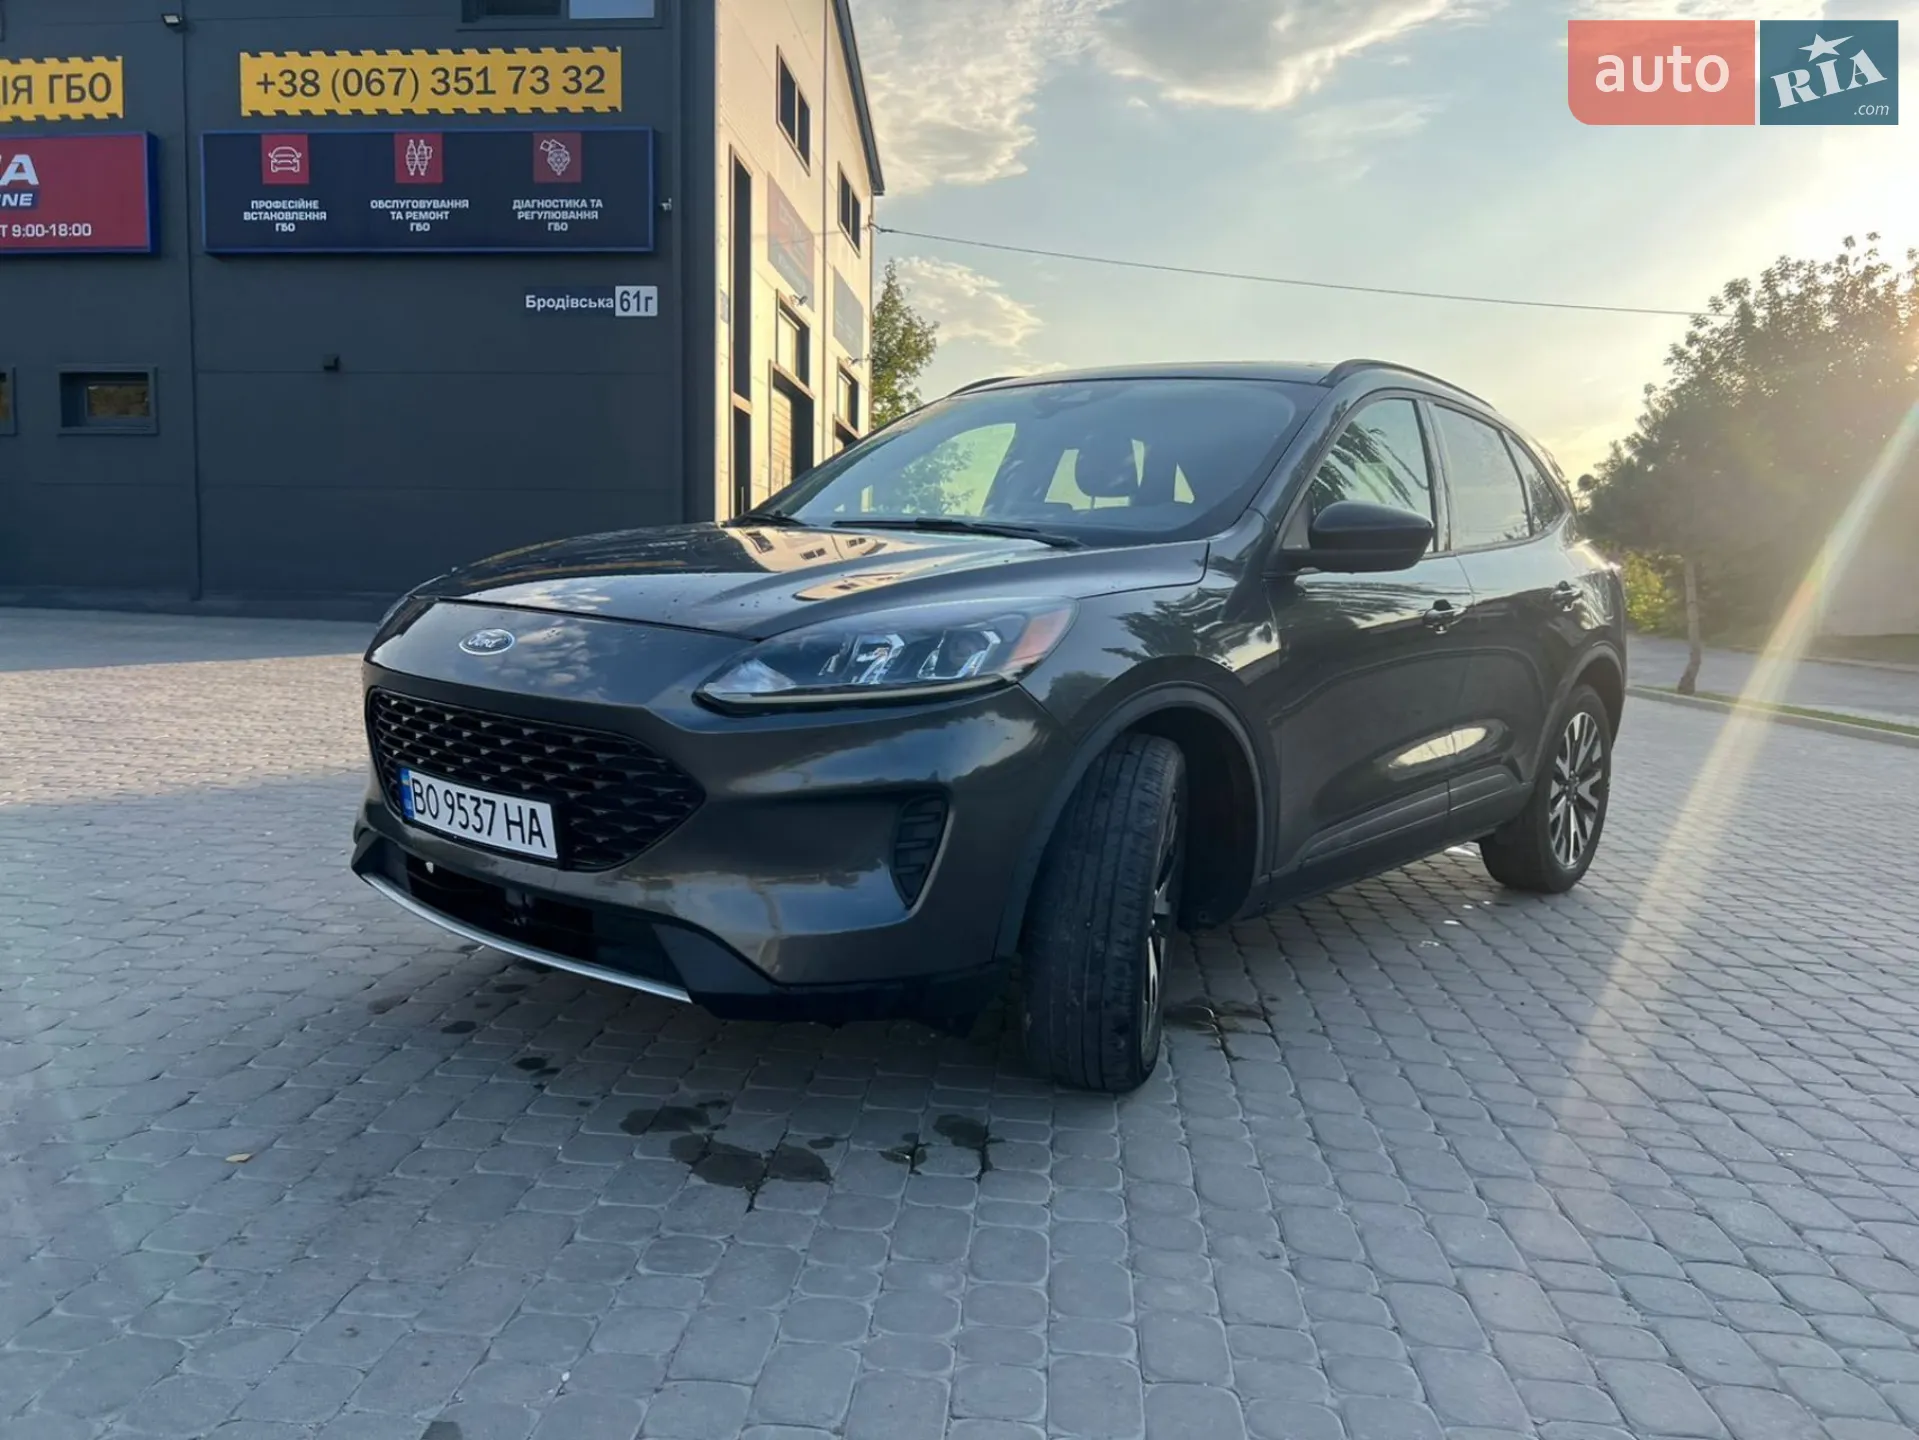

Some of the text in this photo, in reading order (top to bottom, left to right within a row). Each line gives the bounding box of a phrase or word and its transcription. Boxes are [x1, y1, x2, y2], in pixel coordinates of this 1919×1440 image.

[48, 72, 112, 104] ГБО
[256, 65, 605, 102] +38 (067) 351 73 32
[0, 154, 39, 186] A
[0, 193, 33, 207] NE
[250, 198, 319, 210] ПРОФЕСІЙНЕ
[370, 199, 469, 209] ОБСЛУГОВУВАННЯ
[512, 199, 603, 210] ДІАГНОСТИКА ТА
[243, 211, 327, 221] ВСТАНОВЛЕННЯ
[390, 211, 450, 221] ТА РЕМОНТ
[517, 210, 599, 220] РЕГУЛЮВАННЯ
[12, 223, 92, 238] 9:00-18:00
[275, 222, 296, 232] ГБО
[409, 222, 431, 232] ГБО
[547, 221, 569, 231] ГБО
[525, 290, 654, 313] Бродівська 61г
[443, 789, 497, 838] 9537
